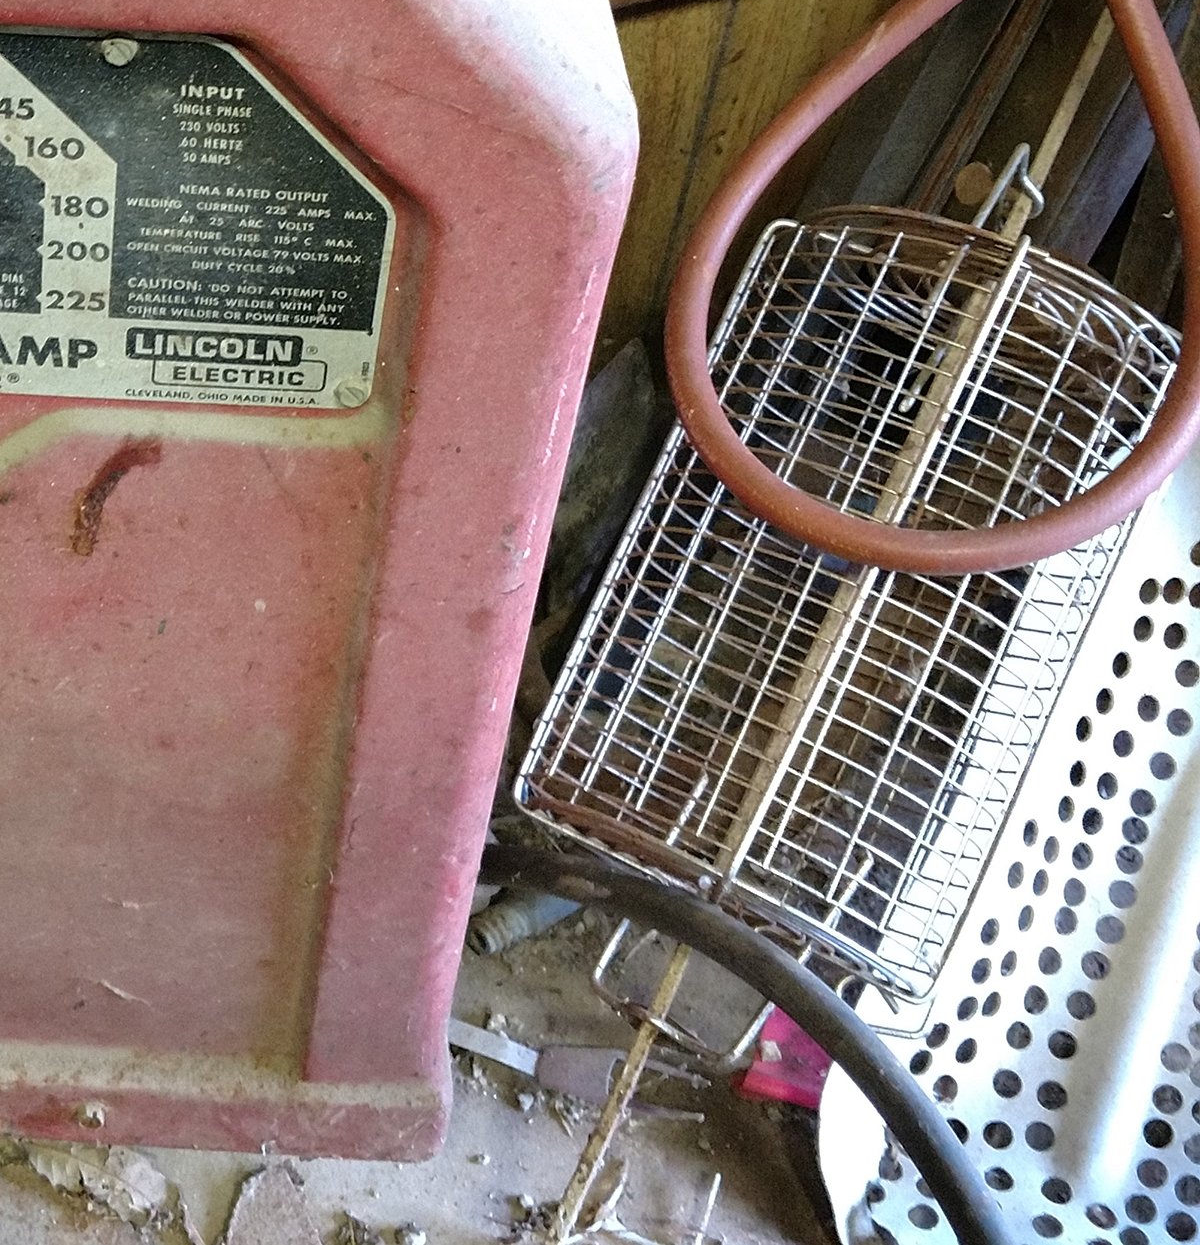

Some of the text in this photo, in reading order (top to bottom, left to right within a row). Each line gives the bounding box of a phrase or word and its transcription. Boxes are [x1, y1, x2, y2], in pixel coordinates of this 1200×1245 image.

[180, 84, 245, 100] INPUT
[172, 103, 253, 118] SINGLE PHASE
[179, 121, 240, 134] 230 VOLTS
[24, 136, 85, 160] 160
[180, 137, 243, 151] 60 HERTZ
[182, 152, 231, 165] 50 AMPS
[179, 184, 329, 203] NEMA RATED OUTPUT
[51, 195, 109, 219] 180
[126, 197, 377, 222] WELDING CURRENT 225 AMPS MAX.
[179, 215, 315, 232] AT 25 ARC VOLTS
[140, 227, 222, 241] TEMPERATURE
[236, 232, 261, 243] RISE
[47, 240, 110, 262] 200
[126, 241, 159, 253] OPEN
[163, 243, 208, 255] CIRCUIT
[213, 247, 269, 259] VOLTAGE
[273, 249, 289, 260] 79
[292, 251, 330, 263] VOLTS
[192, 260, 223, 272] DUTY
[227, 262, 263, 274] CYCLE
[2, 273, 25, 285] DIAL
[127, 277, 202, 293] CAUTION:
[211, 282, 230, 294] DO
[237, 284, 264, 296] NOT
[270, 287, 325, 299] ATTEMPT
[14, 286, 27, 297] 12
[46, 290, 105, 312] 225
[128, 292, 345, 315] PARALLEL THIS WELDER WITH ANY
[126, 305, 167, 317] OTHER
[171, 308, 220, 320] WELDER
[224, 310, 241, 321] OR
[245, 312, 290, 324] POWER
[134, 333, 294, 362] LINCOLN
[173, 365, 305, 386] ELECTRIC
[125, 388, 194, 401] CLEVELAND,
[197, 392, 228, 402] OHIO
[232, 393, 266, 404] MADE
[271, 395, 283, 404] IN
